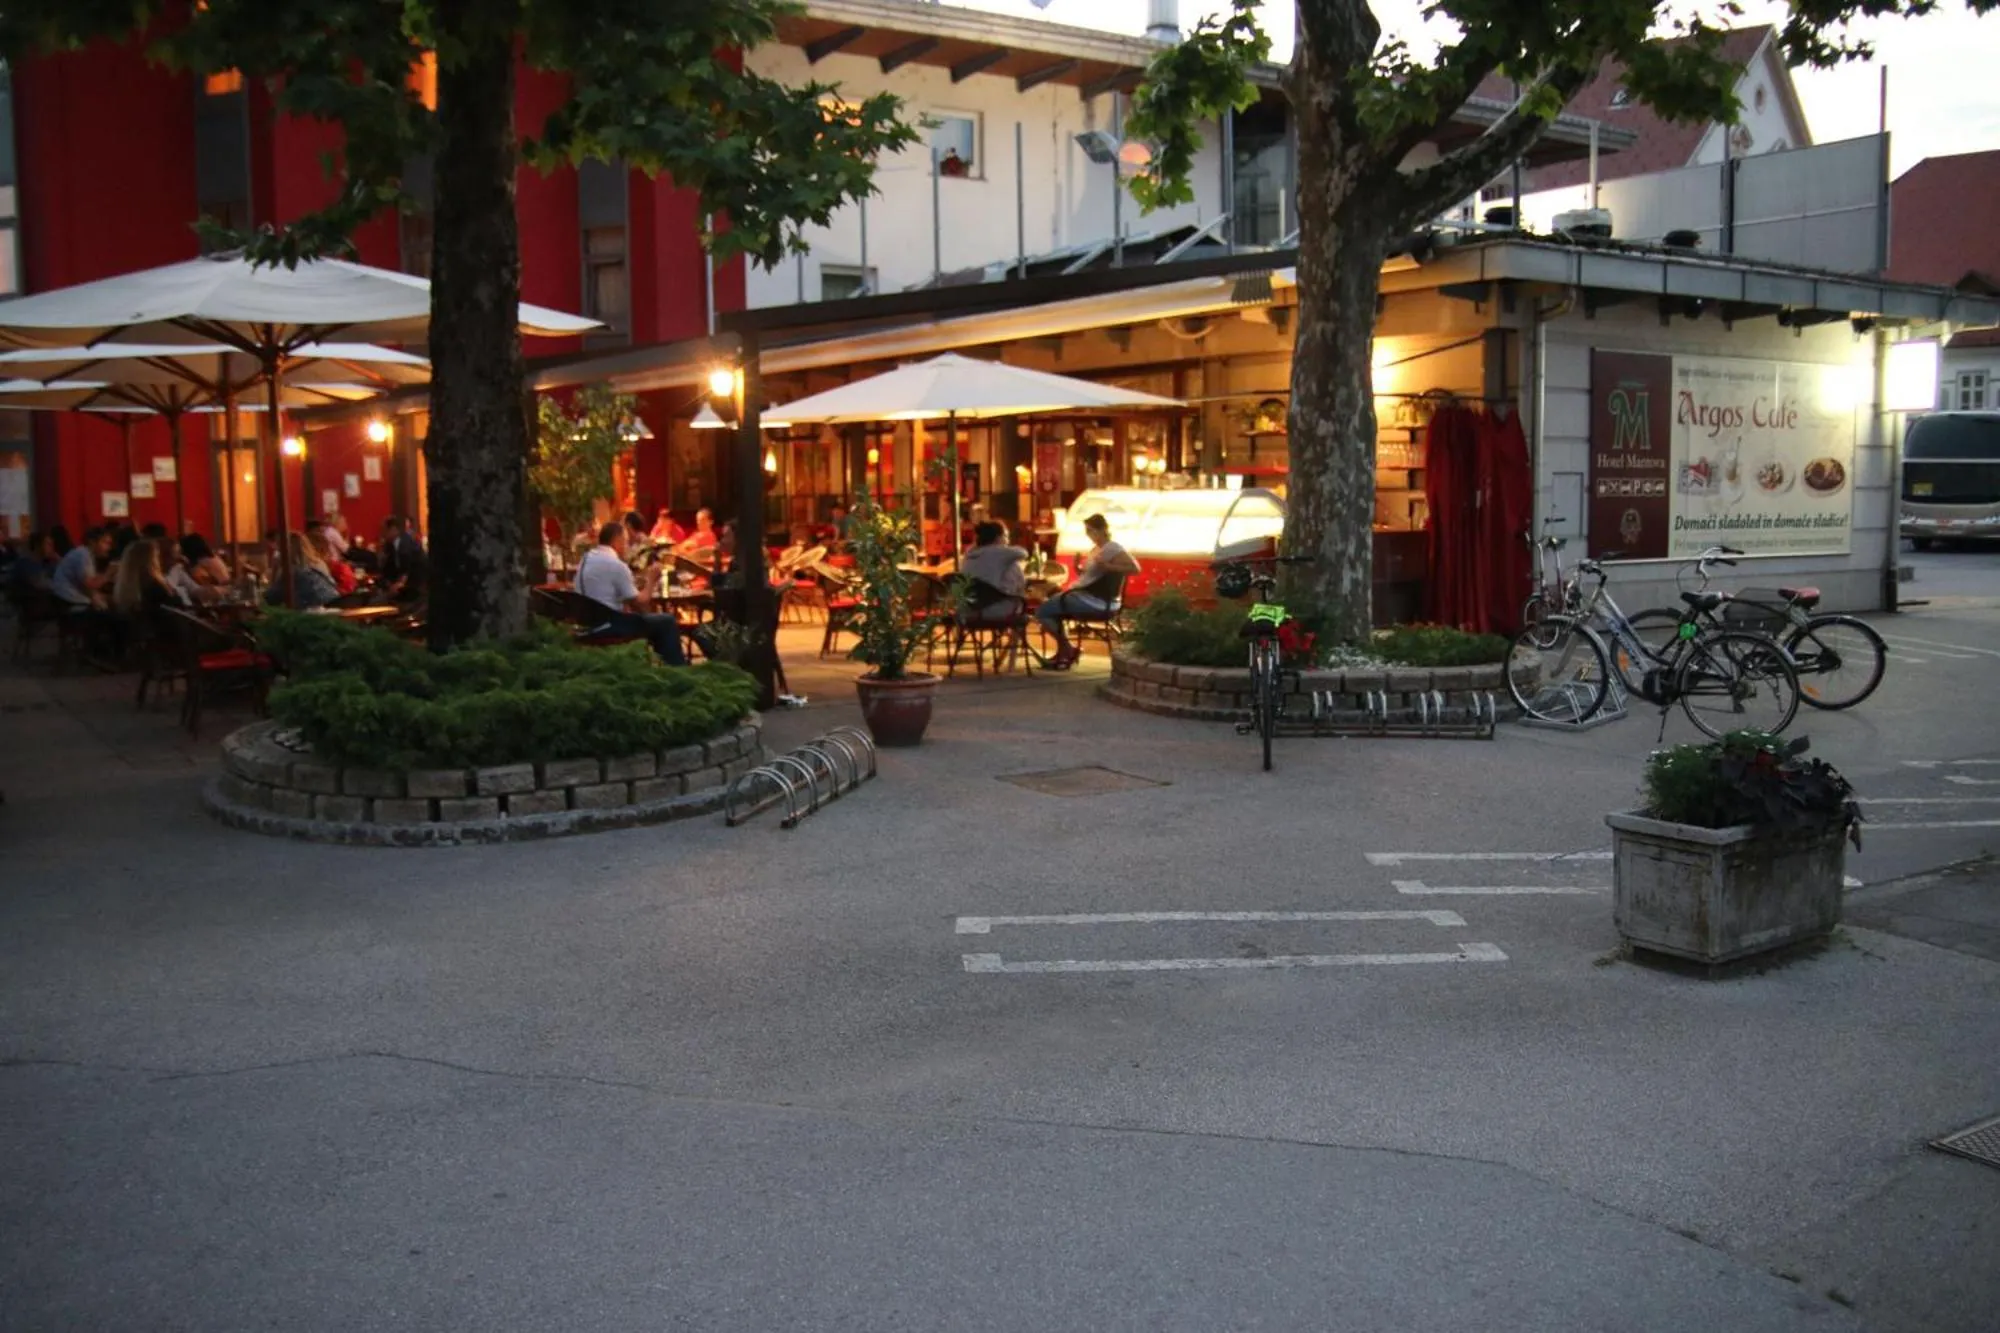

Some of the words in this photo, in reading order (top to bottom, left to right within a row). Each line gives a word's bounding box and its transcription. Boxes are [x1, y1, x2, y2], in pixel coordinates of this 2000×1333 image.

[1608, 389, 1651, 449] M
[1677, 390, 1744, 437] Argos
[1752, 396, 1798, 429] Café
[1718, 512, 1762, 529] sladoled
[1762, 512, 1773, 528] in
